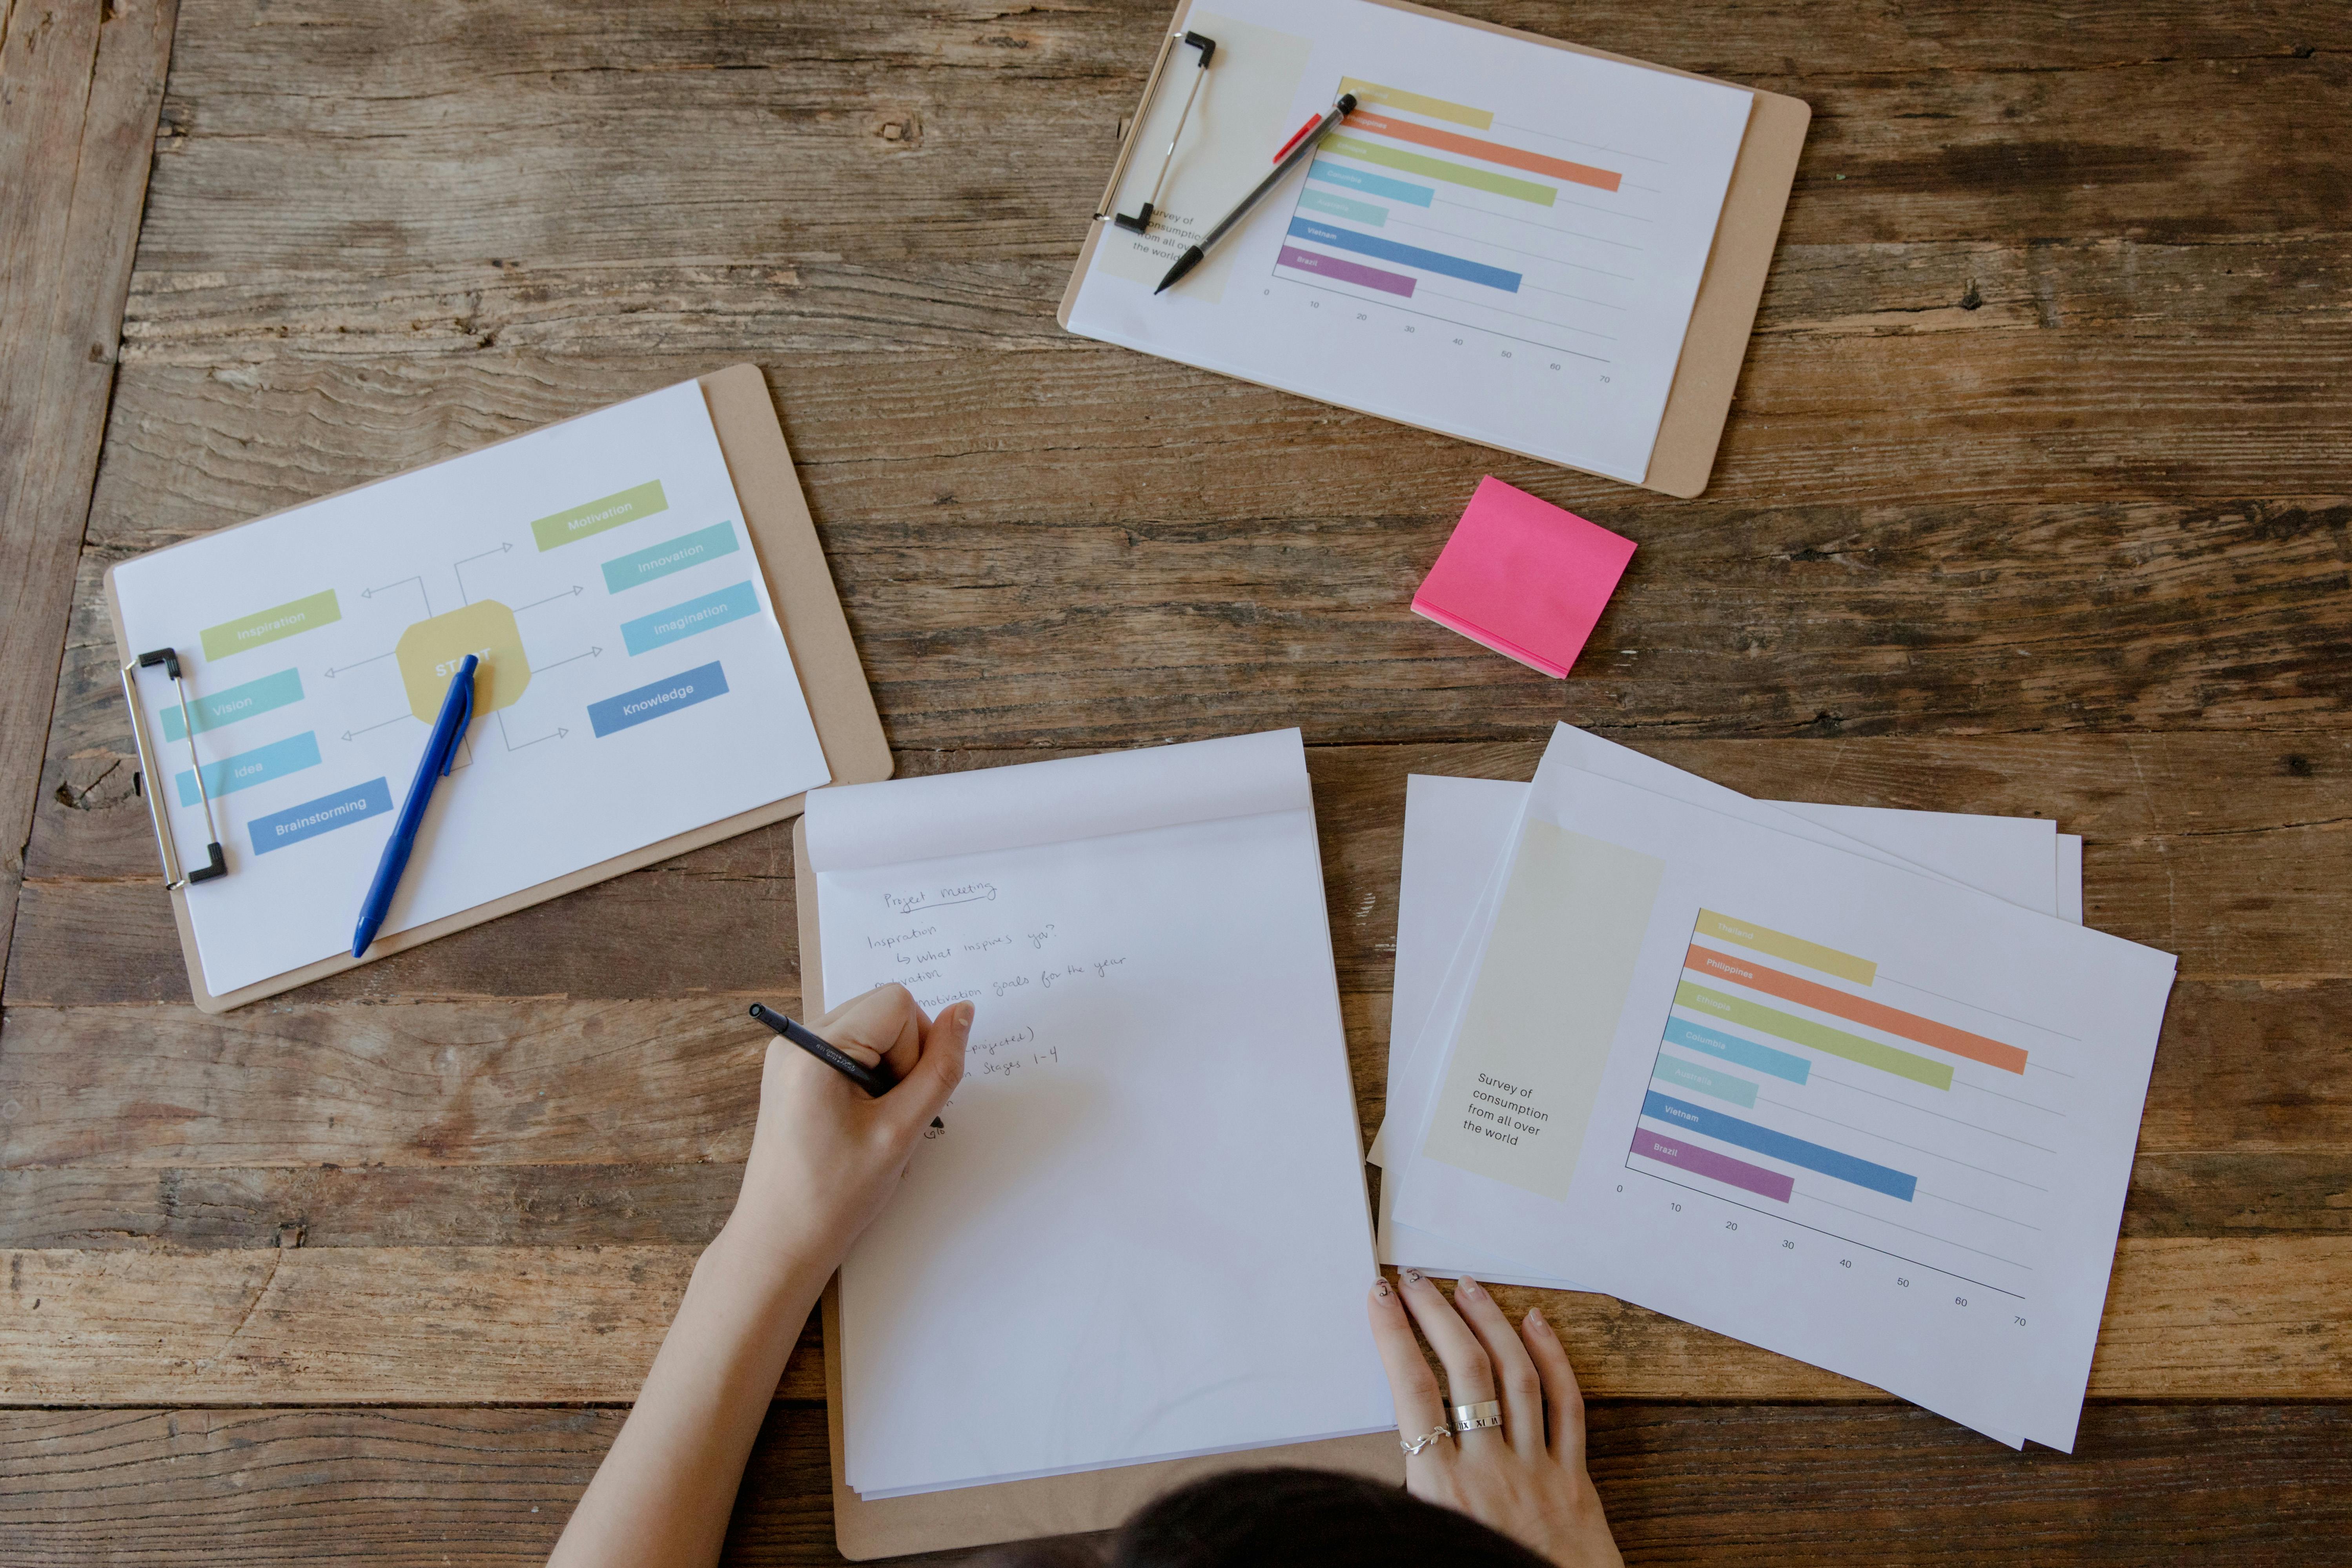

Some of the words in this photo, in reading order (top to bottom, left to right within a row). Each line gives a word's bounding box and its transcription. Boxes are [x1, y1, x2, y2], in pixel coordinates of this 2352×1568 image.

[1152, 209, 1181, 223] urvey
[1149, 221, 1201, 240] onsumptio
[1308, 227, 1337, 240] Vietnam
[1133, 242, 1149, 253] the
[1163, 239, 1175, 247] all
[1297, 256, 1317, 266] Brazil
[1599, 375, 1610, 383] 70
[568, 502, 633, 531] Motivation
[638, 543, 704, 573] Innovation
[237, 612, 305, 640] Inspiration
[654, 603, 728, 635] Imagination
[212, 697, 253, 716] Vision
[623, 685, 694, 716] Knowledge
[235, 763, 263, 778] Idea
[275, 799, 367, 836] Brainstorming
[884, 892, 925, 913] Project
[867, 922, 936, 949] Inspiration
[1718, 922, 1754, 940] Thailand
[993, 976, 1029, 996] goals
[1042, 971, 1061, 988] for
[1068, 965, 1084, 975] the
[1094, 957, 1126, 977] year
[1706, 958, 1753, 979] Philippines
[1696, 994, 1731, 1011] Ethiopia
[1686, 1031, 1725, 1049] Columbia
[1478, 1073, 1518, 1095] Survey
[1520, 1089, 1533, 1098] of
[1674, 1069, 1712, 1086] Australia
[1473, 1090, 1548, 1121] consumption
[1665, 1105, 1699, 1122] Vietnam
[1468, 1104, 1494, 1120] from
[1497, 1116, 1511, 1126] all
[1514, 1122, 1540, 1135] over
[1463, 1120, 1482, 1133] the
[1485, 1128, 1518, 1145] world
[1654, 1142, 1678, 1157] Brazil
[1671, 1202, 1682, 1212] 10
[1725, 1221, 1738, 1231] 20
[1782, 1240, 1794, 1249] 30
[1839, 1259, 1851, 1268] 40
[1897, 1277, 1909, 1287] 50
[1955, 1297, 1968, 1307] 60
[2014, 1316, 2026, 1326] 70
